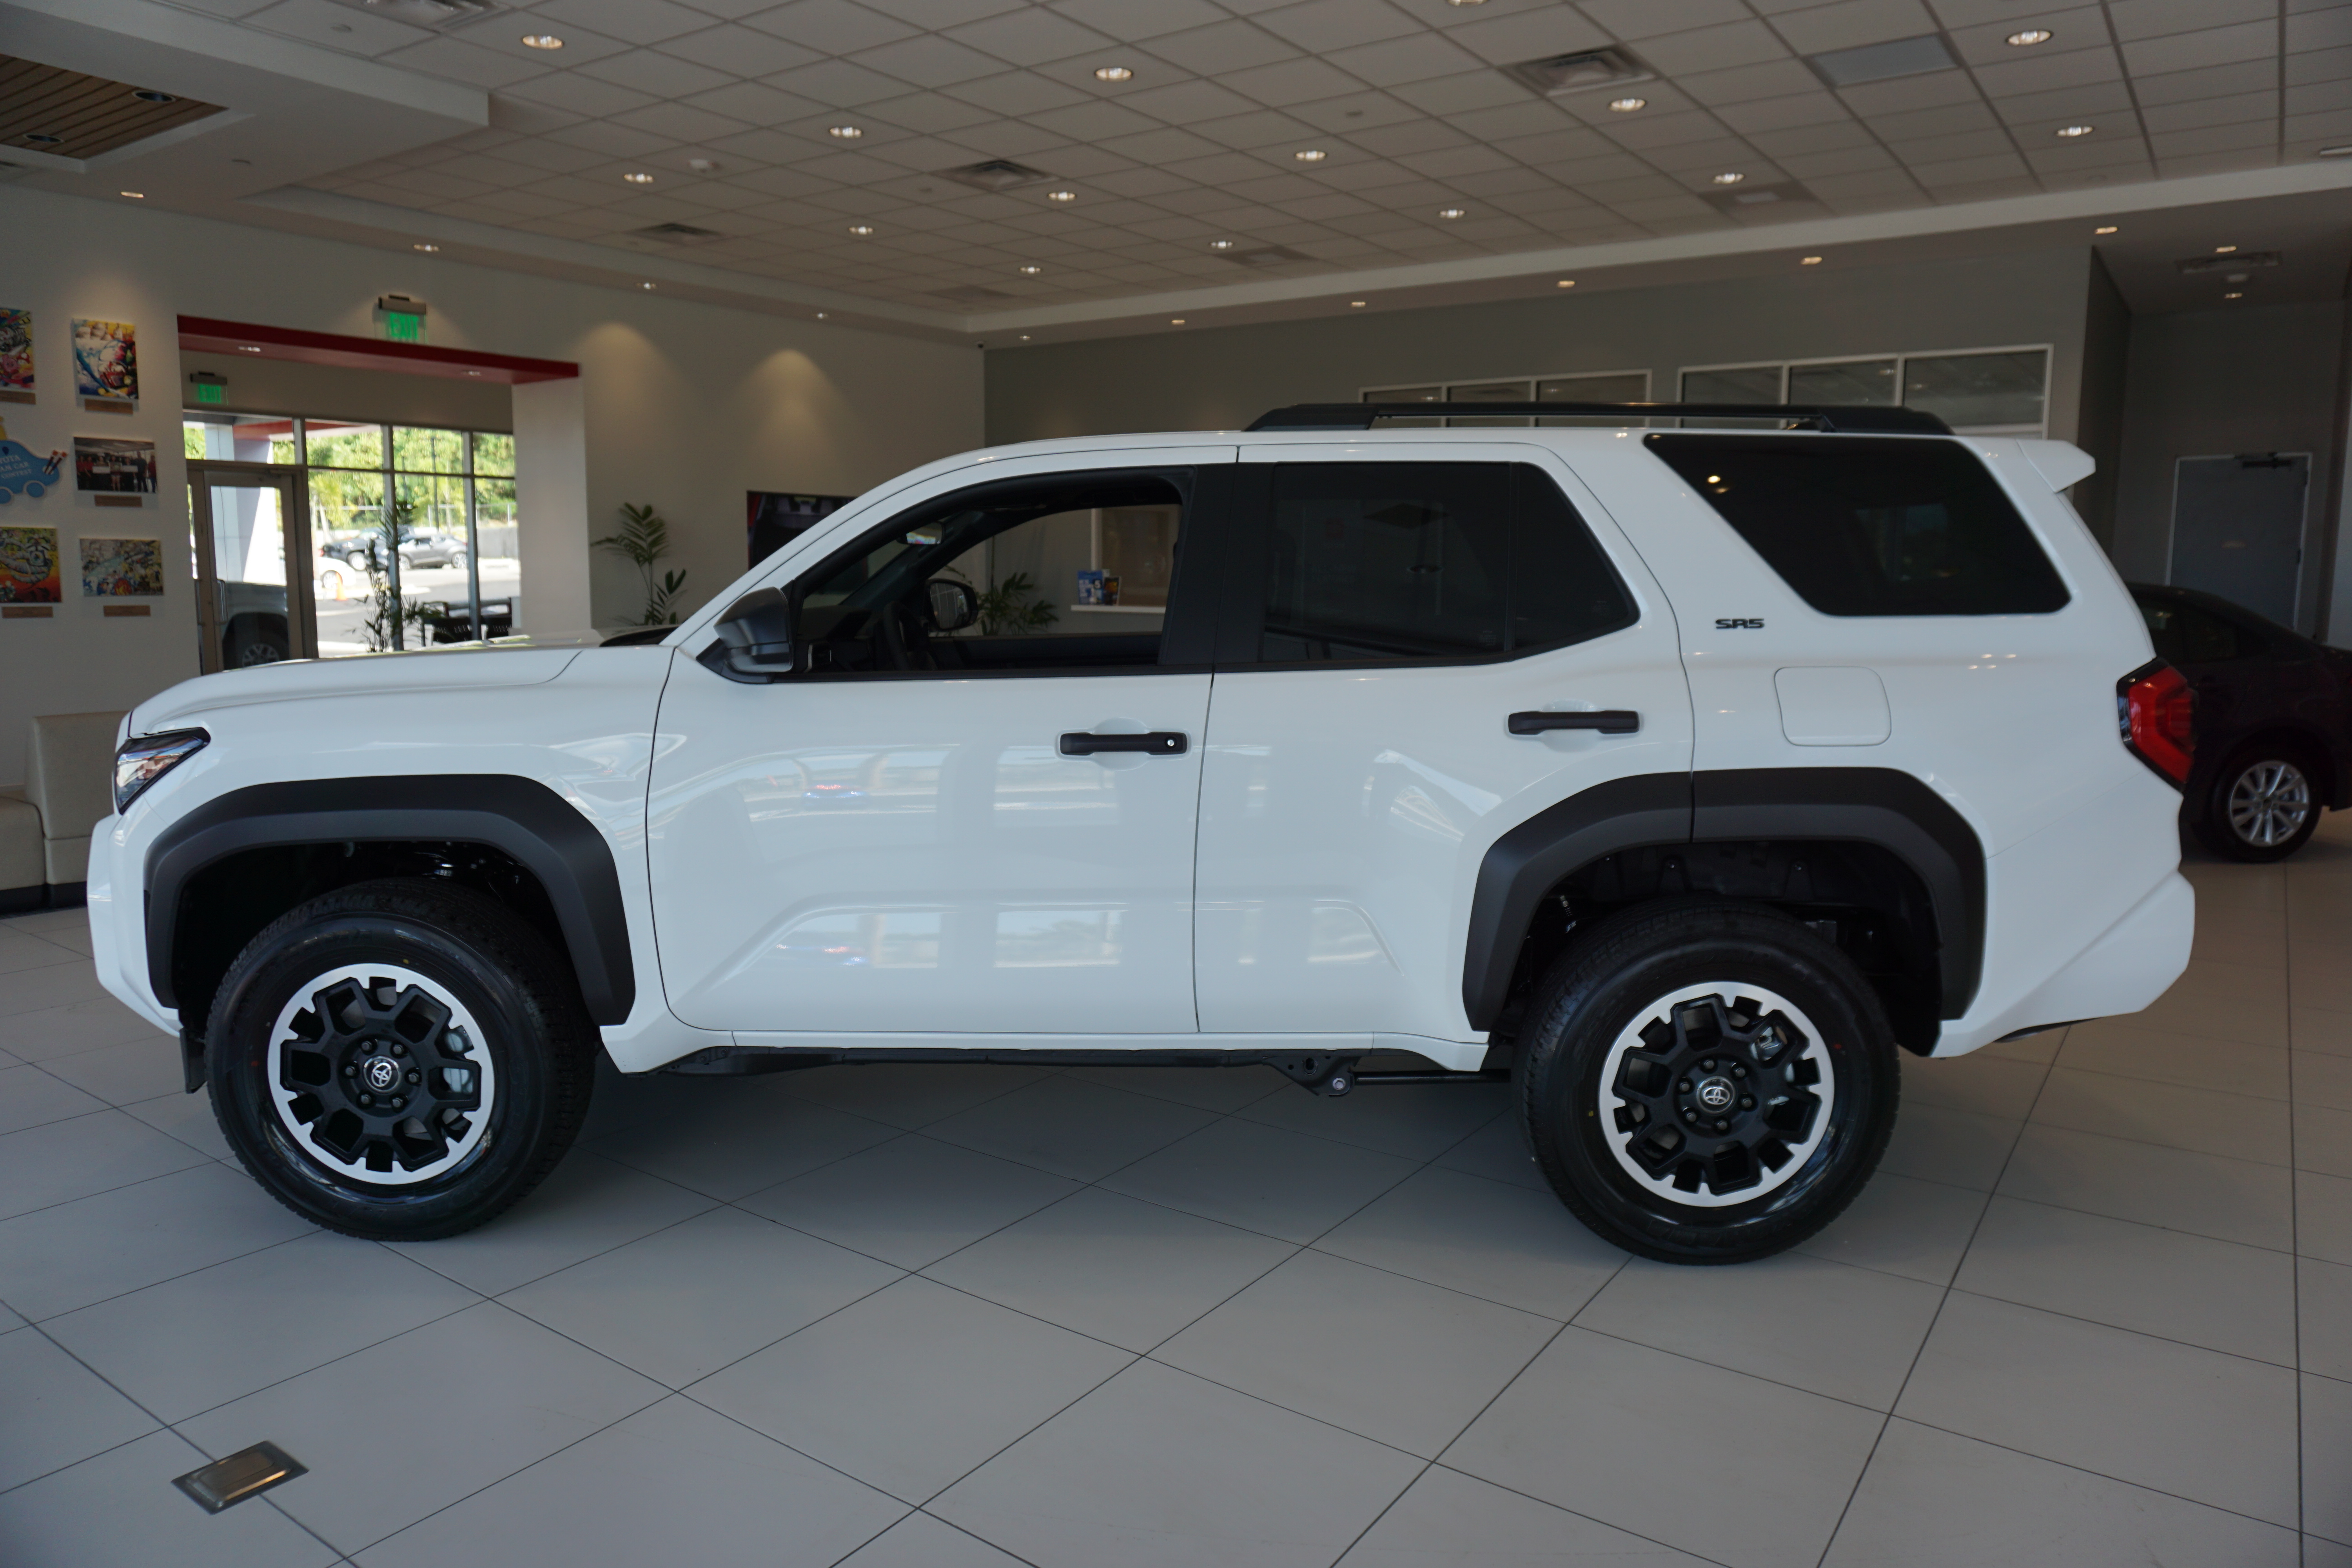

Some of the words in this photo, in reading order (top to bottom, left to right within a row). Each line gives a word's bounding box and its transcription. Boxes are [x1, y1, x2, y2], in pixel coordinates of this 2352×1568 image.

[390, 312, 418, 340] EXIT
[199, 384, 221, 404] EXIT
[1715, 619, 1765, 629] SR5
